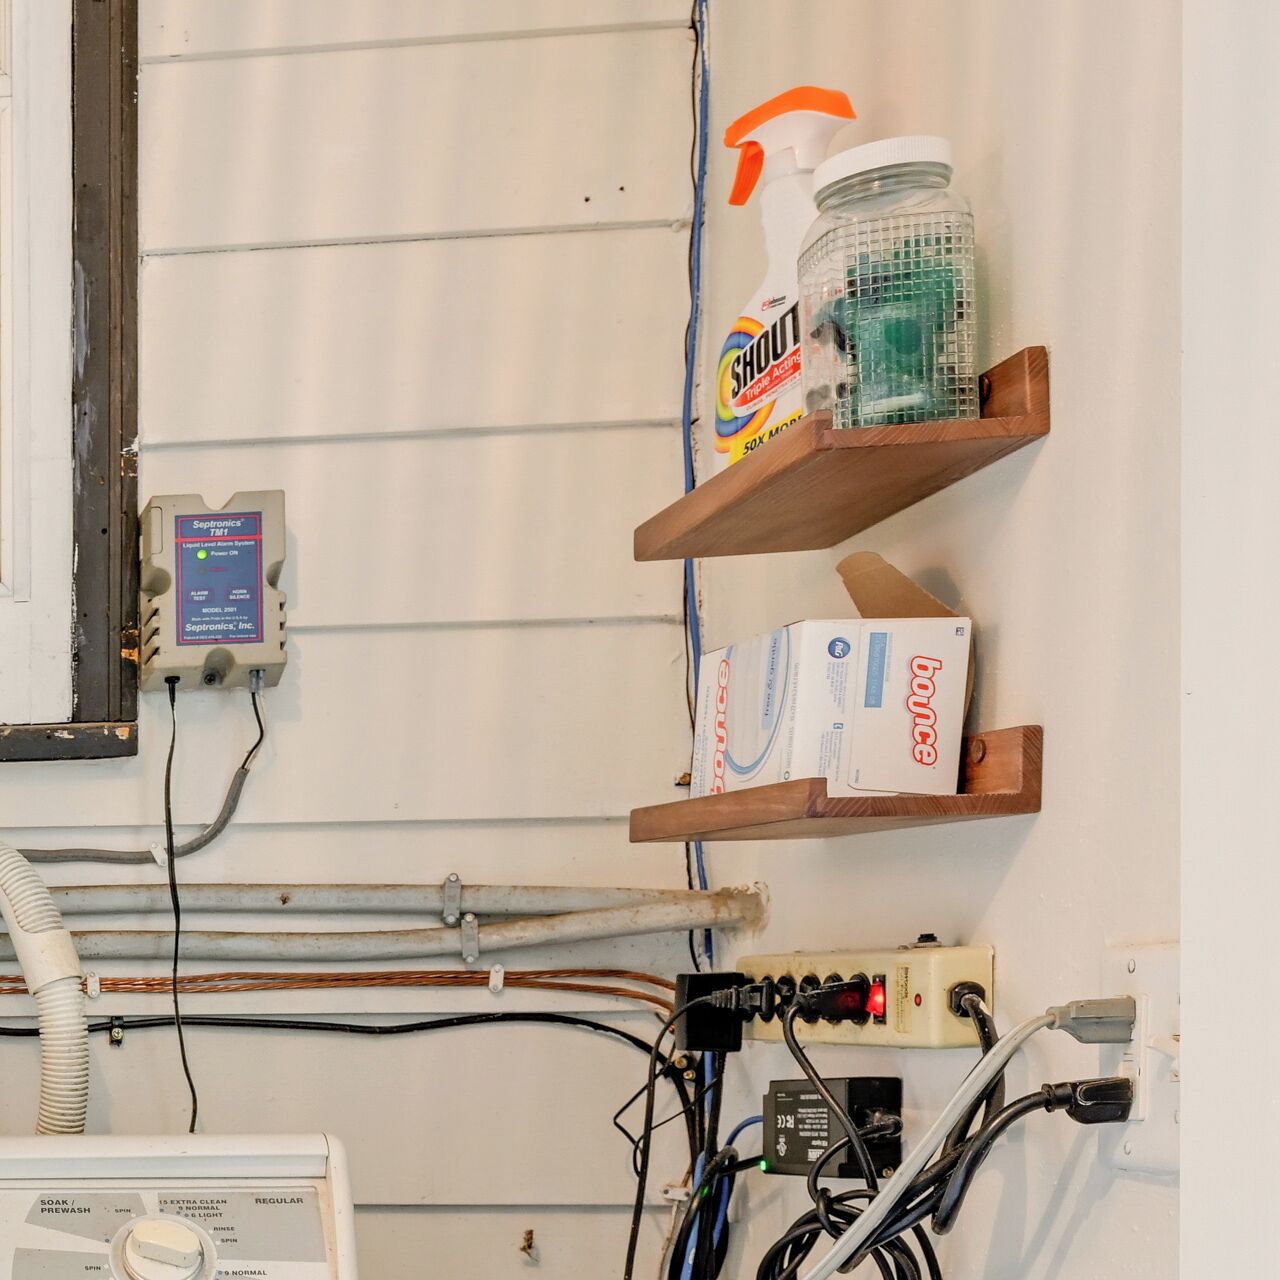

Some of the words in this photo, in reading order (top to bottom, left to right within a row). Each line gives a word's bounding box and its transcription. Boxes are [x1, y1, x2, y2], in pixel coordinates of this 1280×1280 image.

[731, 301, 799, 399] SHOUT
[745, 376, 770, 400] Triple
[743, 434, 766, 456] 50X
[193, 519, 242, 529] Septronics
[210, 528, 228, 536] TM1
[238, 622, 255, 630] Inc.
[907, 656, 942, 765] bounce
